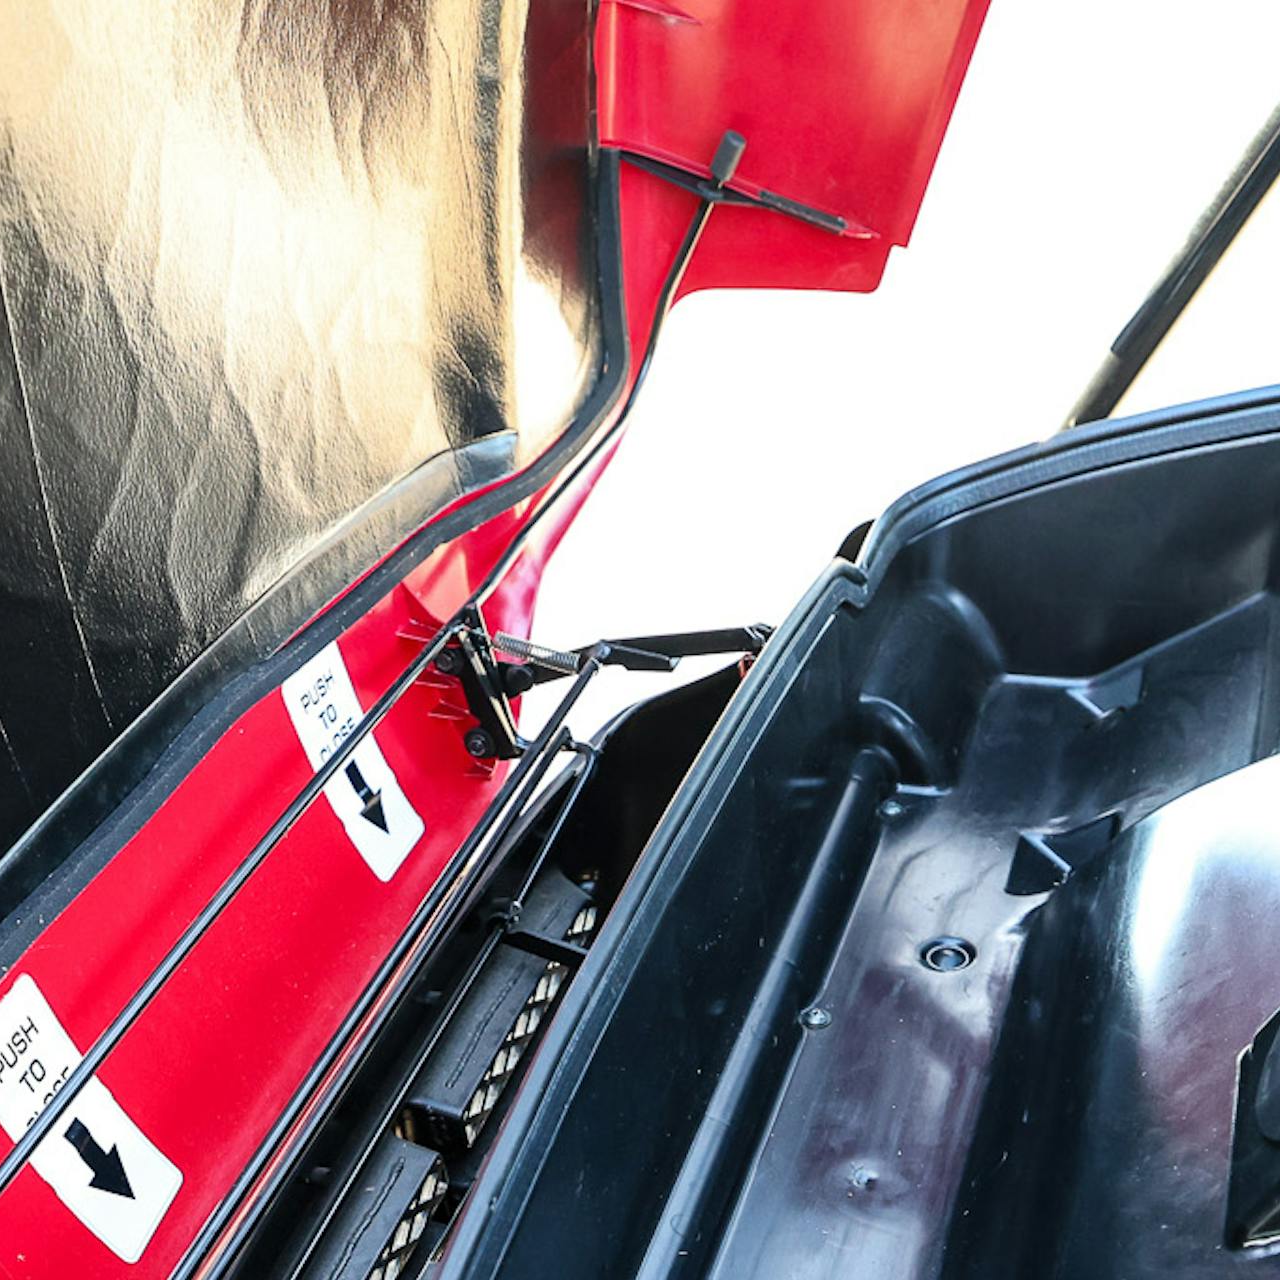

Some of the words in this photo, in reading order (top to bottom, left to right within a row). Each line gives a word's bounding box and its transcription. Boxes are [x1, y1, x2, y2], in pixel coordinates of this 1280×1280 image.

[300, 667, 334, 714] PUSH
[318, 704, 337, 729] TO
[19, 1059, 46, 1093] TO
